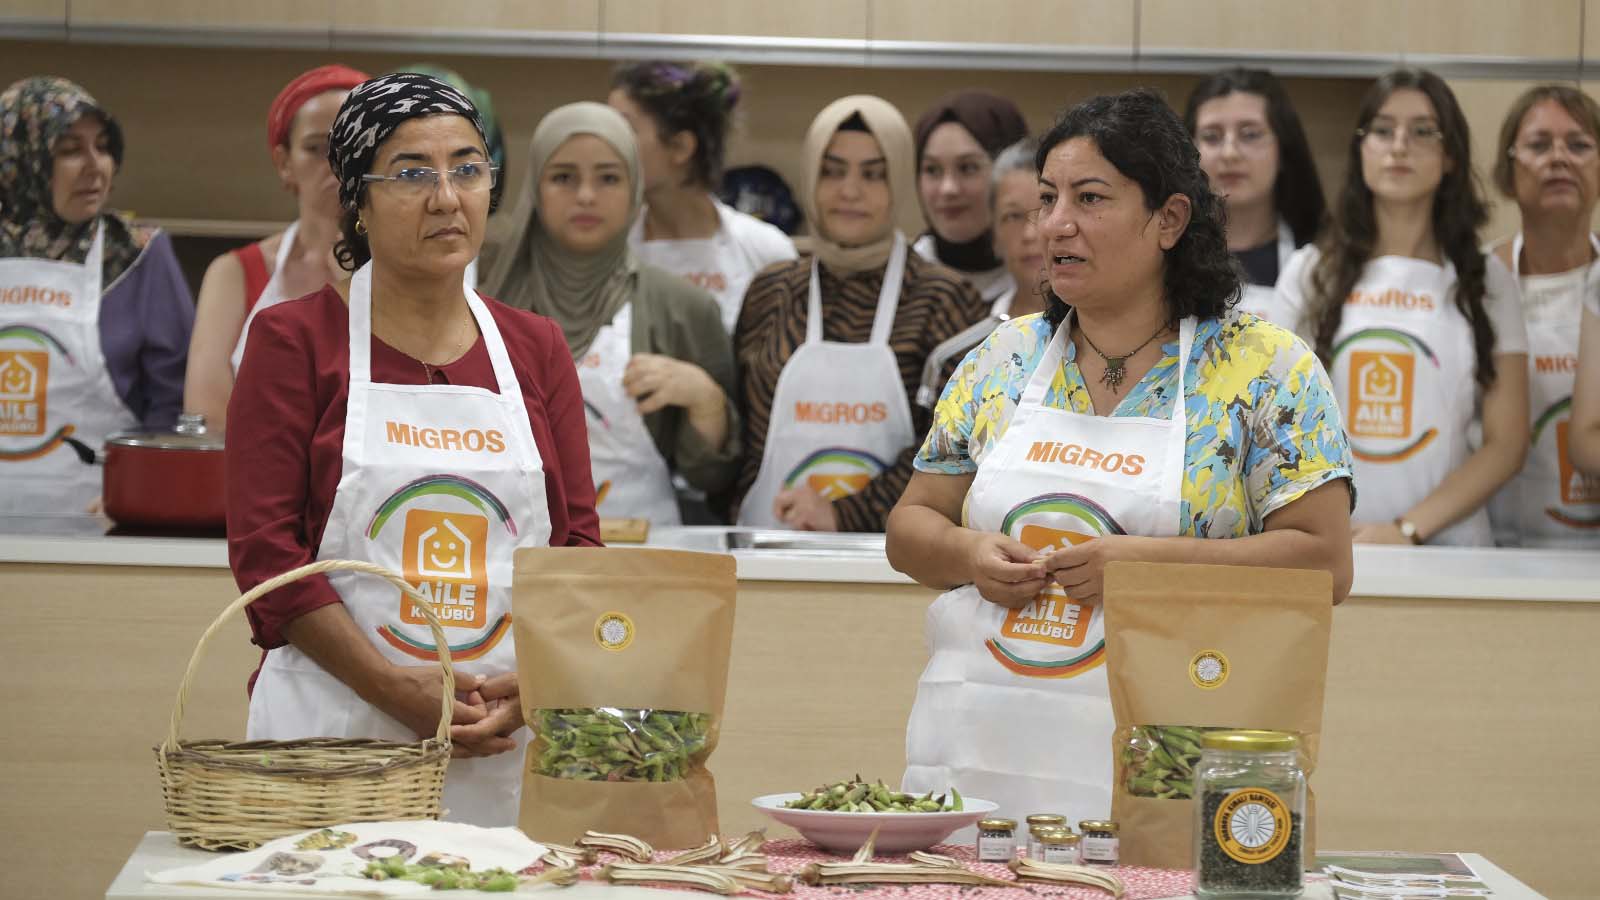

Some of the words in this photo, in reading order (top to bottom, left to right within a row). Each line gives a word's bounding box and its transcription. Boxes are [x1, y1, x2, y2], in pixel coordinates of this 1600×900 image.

[795, 401, 888, 425] MiGROS
[385, 421, 506, 453] MiGROS
[1025, 441, 1146, 475] MiGROS
[416, 580, 476, 606] AiLE
[411, 604, 475, 621] KLÜBÜ
[1017, 599, 1080, 625] AiLE
[1012, 621, 1075, 640] KULÜBÜ
